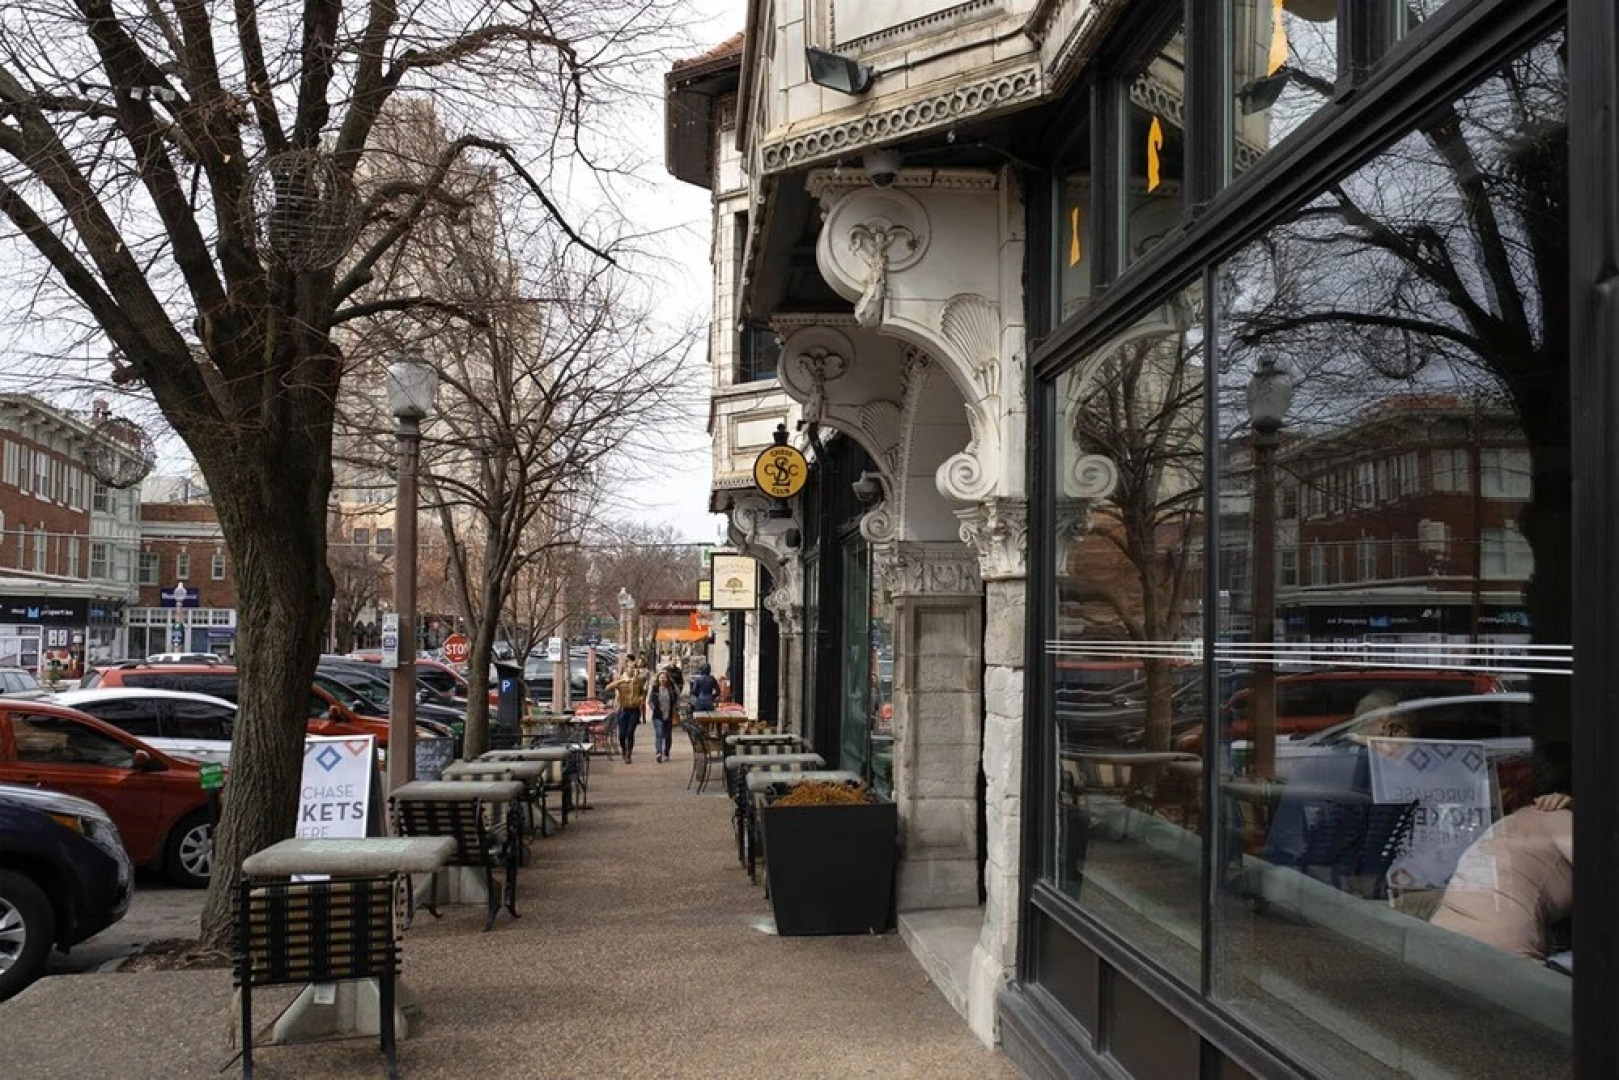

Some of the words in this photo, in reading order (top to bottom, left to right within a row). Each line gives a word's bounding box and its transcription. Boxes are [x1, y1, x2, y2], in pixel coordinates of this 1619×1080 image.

[502, 680, 510, 692] P
[302, 784, 353, 799] CHASE
[302, 801, 364, 821] KETS
[297, 826, 331, 838] ERE
